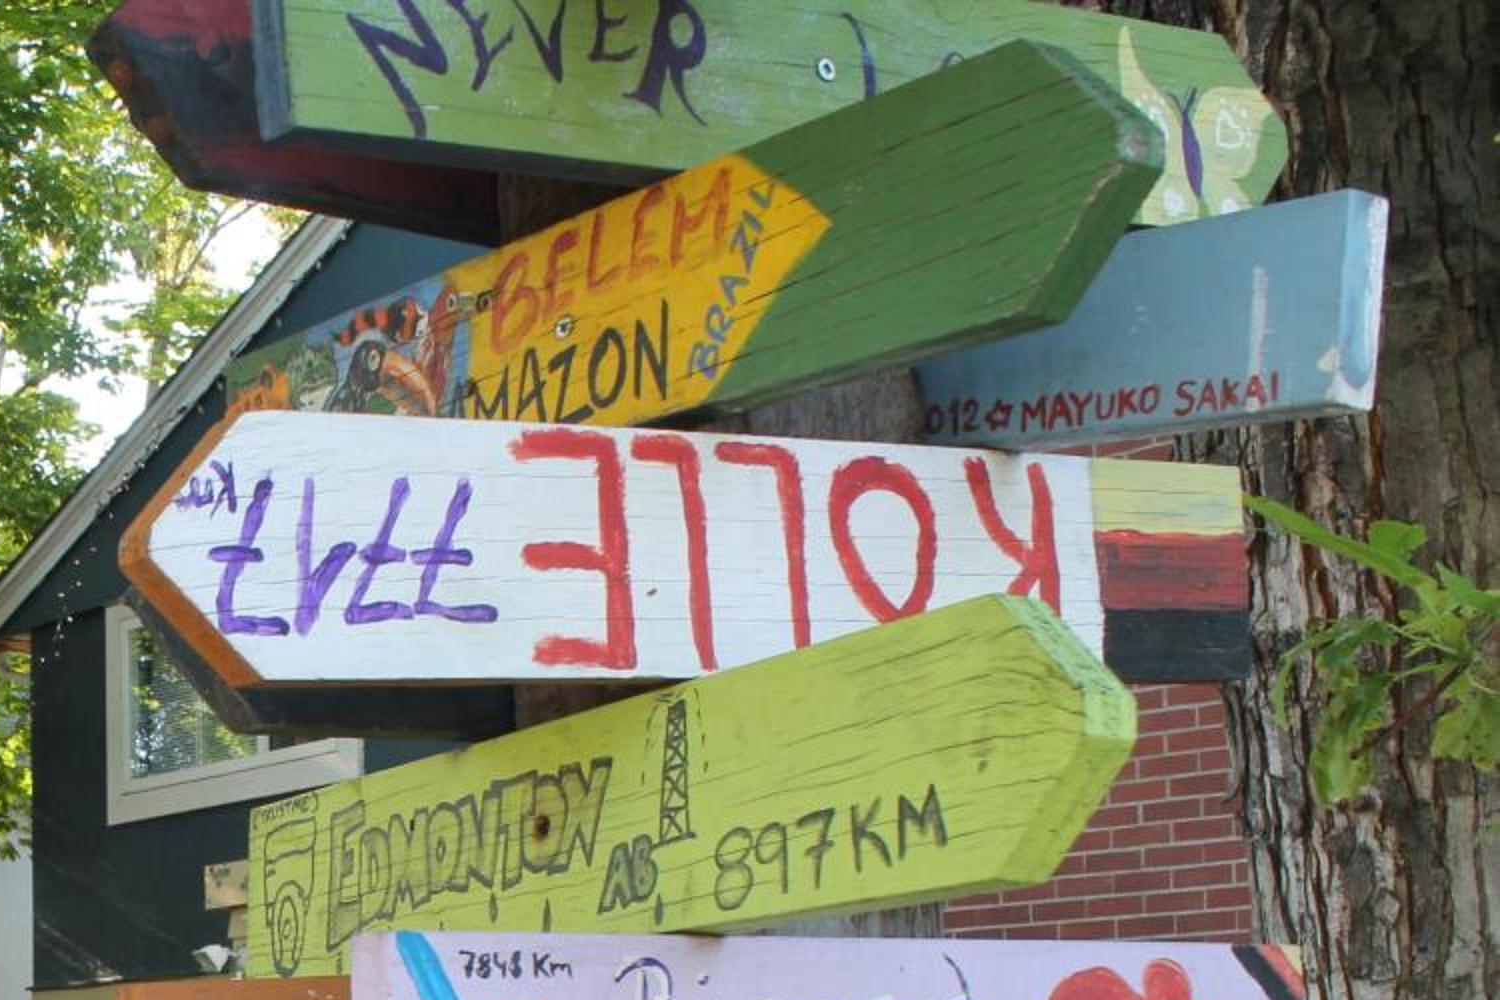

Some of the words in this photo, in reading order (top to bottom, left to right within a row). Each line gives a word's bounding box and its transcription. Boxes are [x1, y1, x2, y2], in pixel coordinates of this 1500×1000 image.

[486, 166, 733, 356] BELEM
[687, 181, 776, 381] BRAZIL
[1021, 383, 1162, 433] MAYUKO
[1174, 372, 1280, 417] SAKAI
[506, 427, 1063, 672] KOLLE
[326, 756, 614, 952] EDMONTON
